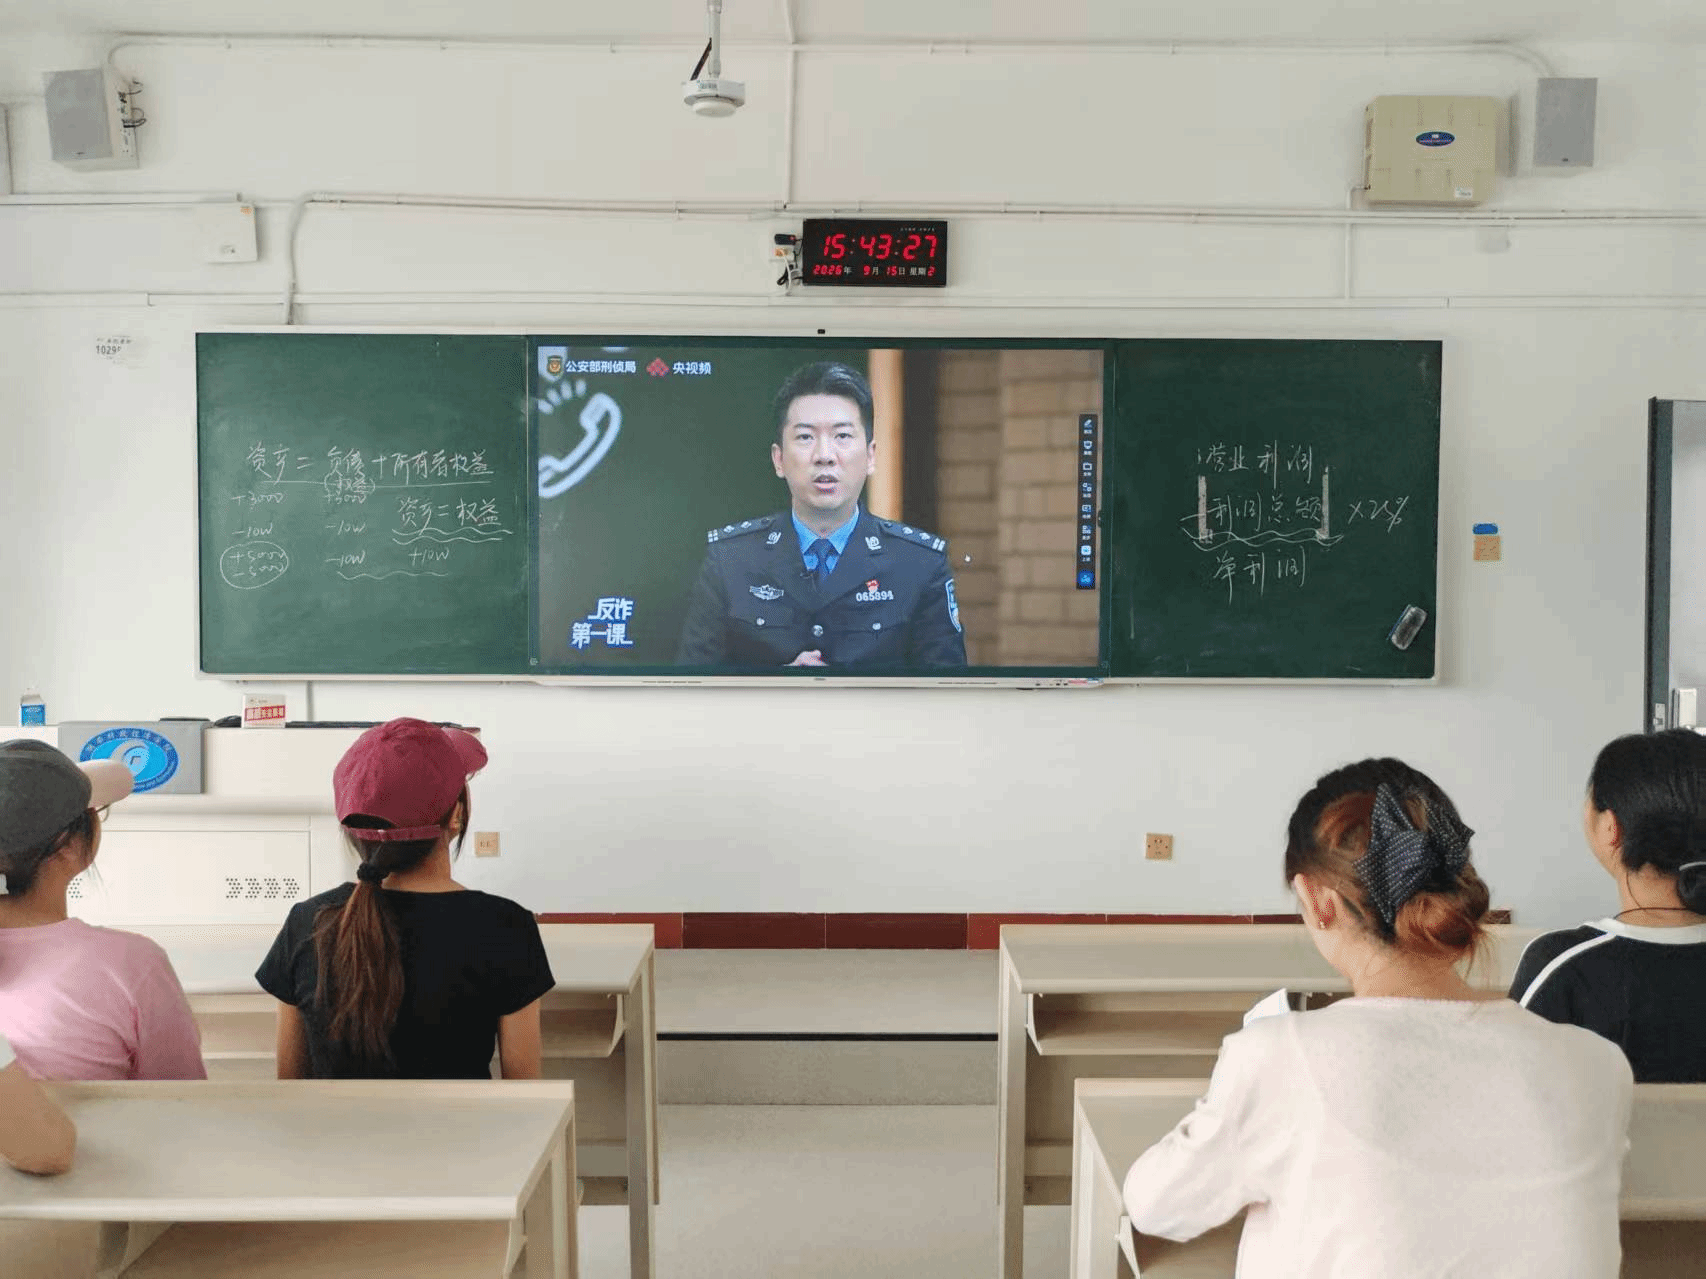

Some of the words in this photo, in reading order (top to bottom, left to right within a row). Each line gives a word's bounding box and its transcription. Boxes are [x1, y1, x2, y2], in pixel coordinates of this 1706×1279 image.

[823, 233, 938, 260] 15:43:27
[565, 360, 637, 374] 公安部刑侦局
[672, 361, 712, 375] 央视频
[587, 597, 635, 620] 反诈
[570, 622, 634, 649] 第一课
